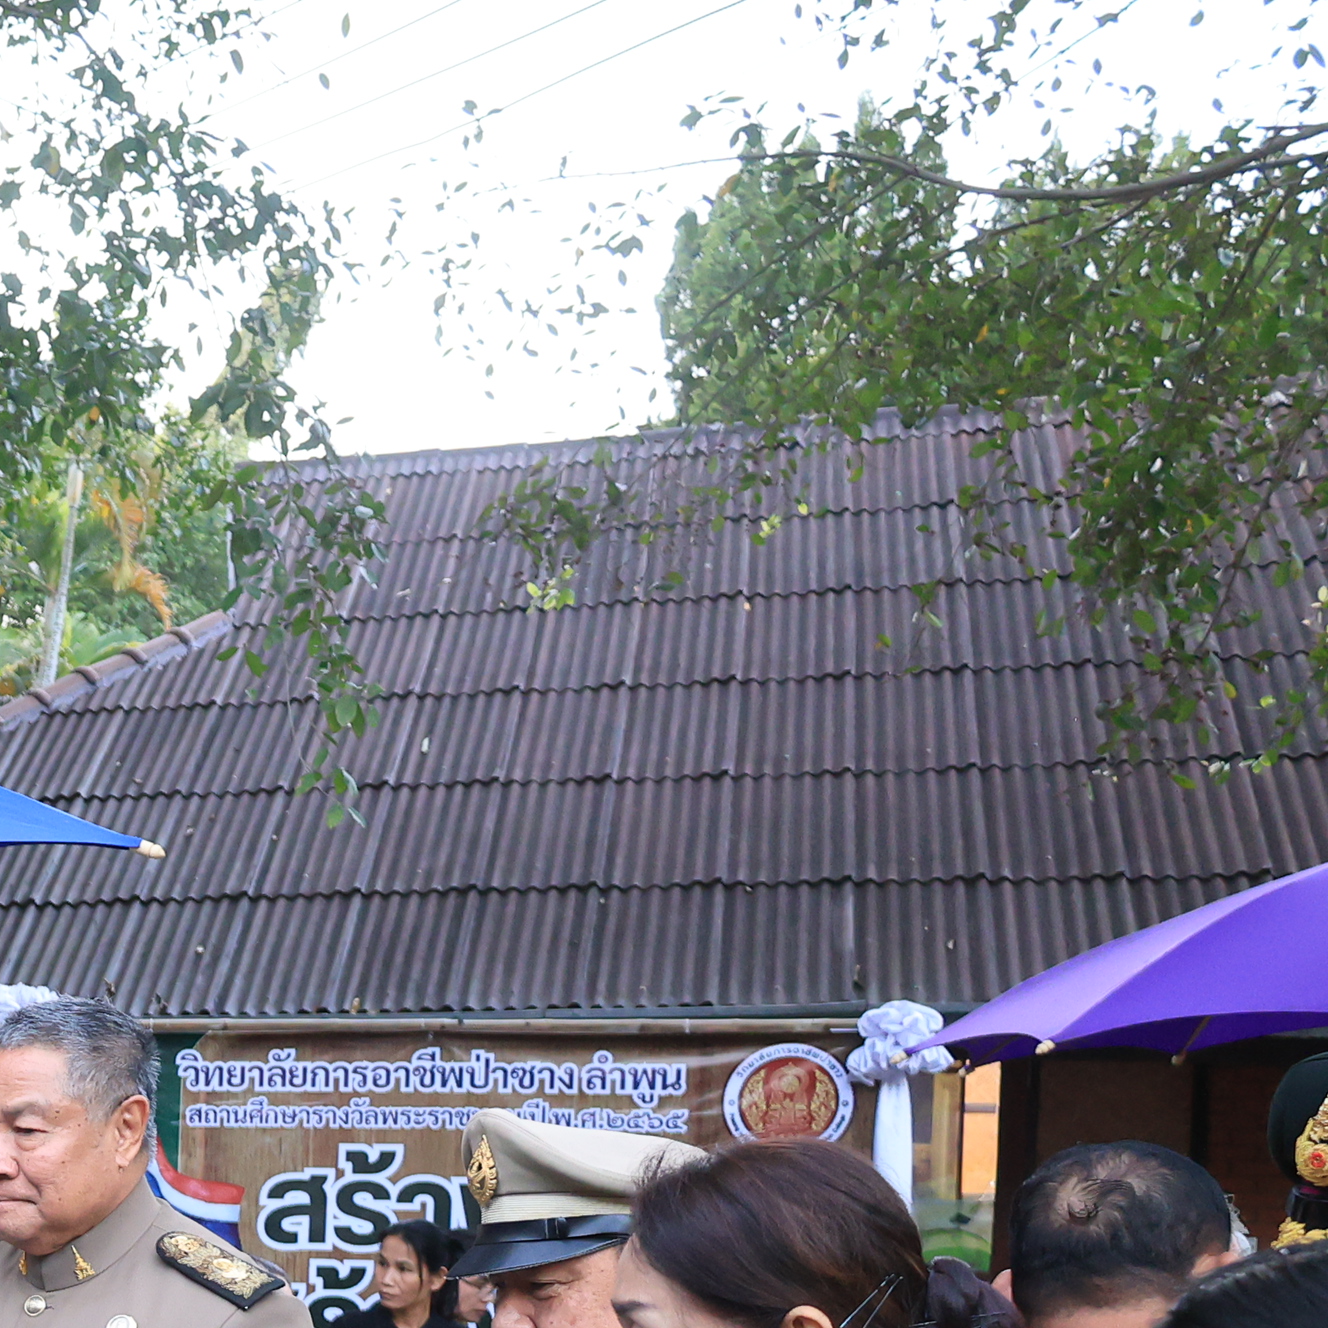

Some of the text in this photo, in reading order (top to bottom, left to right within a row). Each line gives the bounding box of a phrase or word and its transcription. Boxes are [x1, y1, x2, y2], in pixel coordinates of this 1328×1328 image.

[177, 1047, 688, 1107] วิทยาลัยการอาชีพป่าซาง ลำพูน
